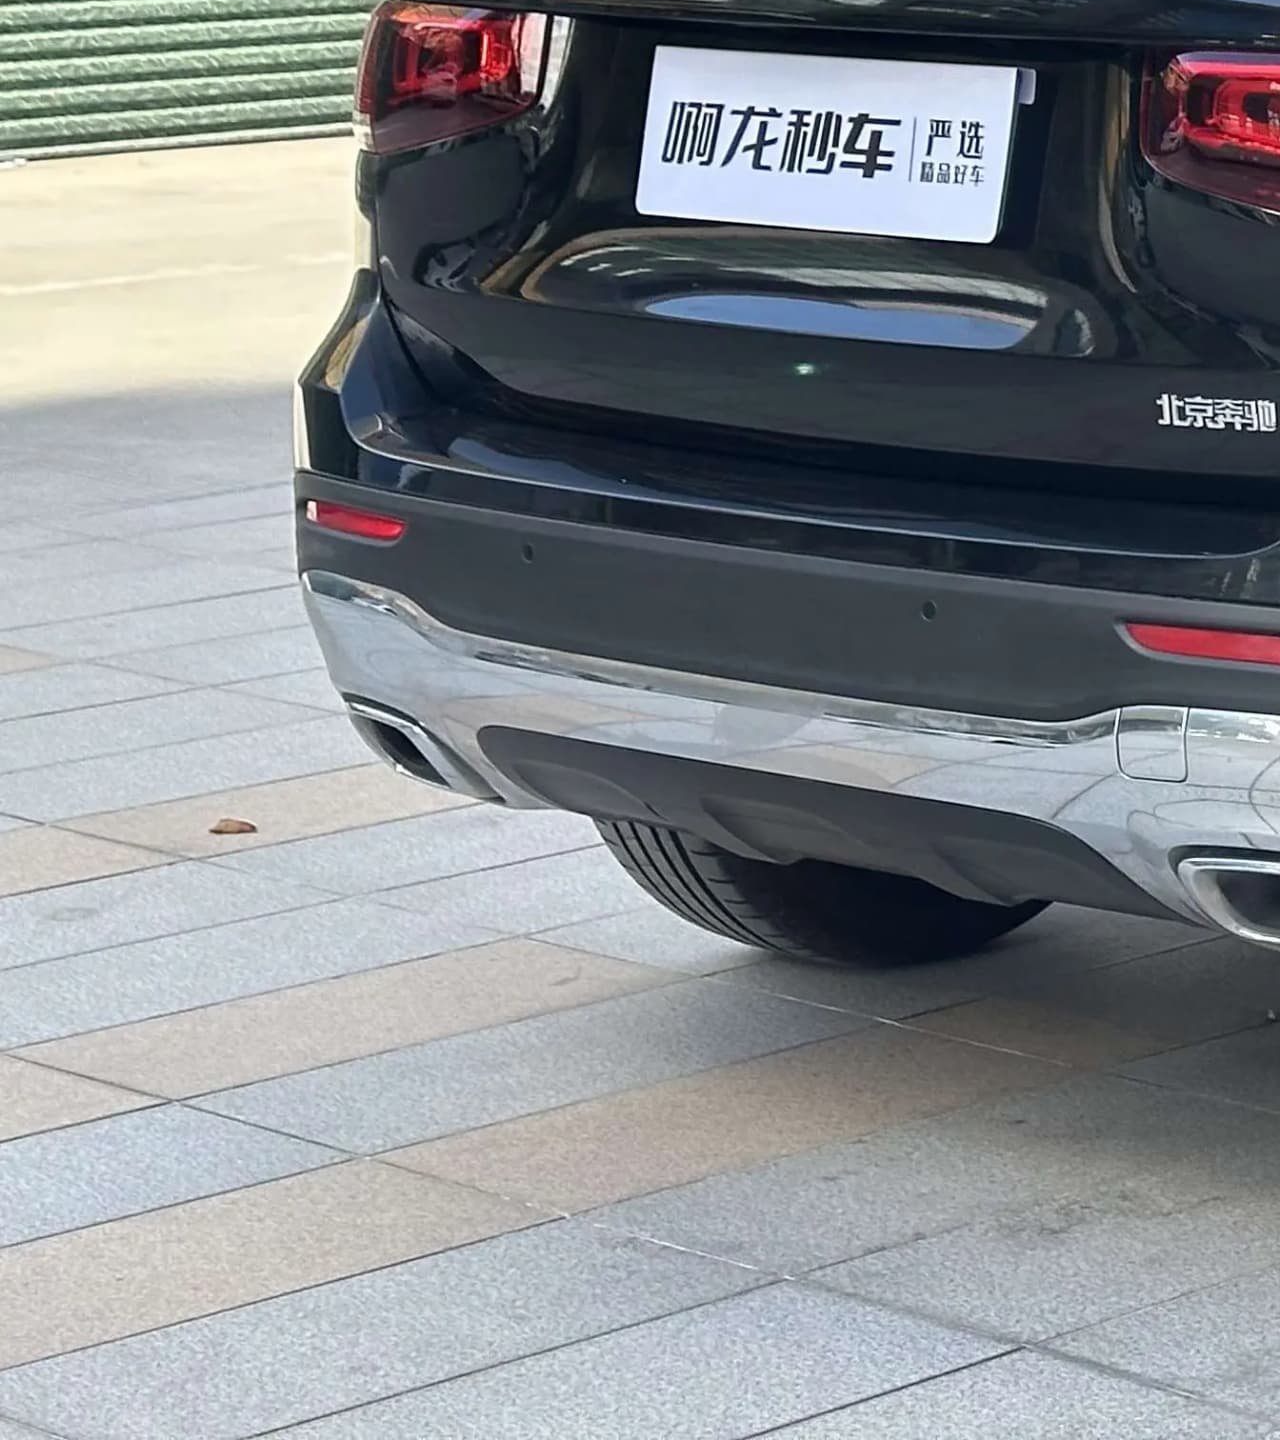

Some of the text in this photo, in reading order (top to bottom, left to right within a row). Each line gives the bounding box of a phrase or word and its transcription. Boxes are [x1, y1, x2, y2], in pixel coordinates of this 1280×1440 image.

[660, 100, 902, 179] 啊龙秒车
[925, 118, 985, 160] 严选
[919, 161, 985, 187] 精品好车
[1155, 392, 1278, 432] 北京奔驰
